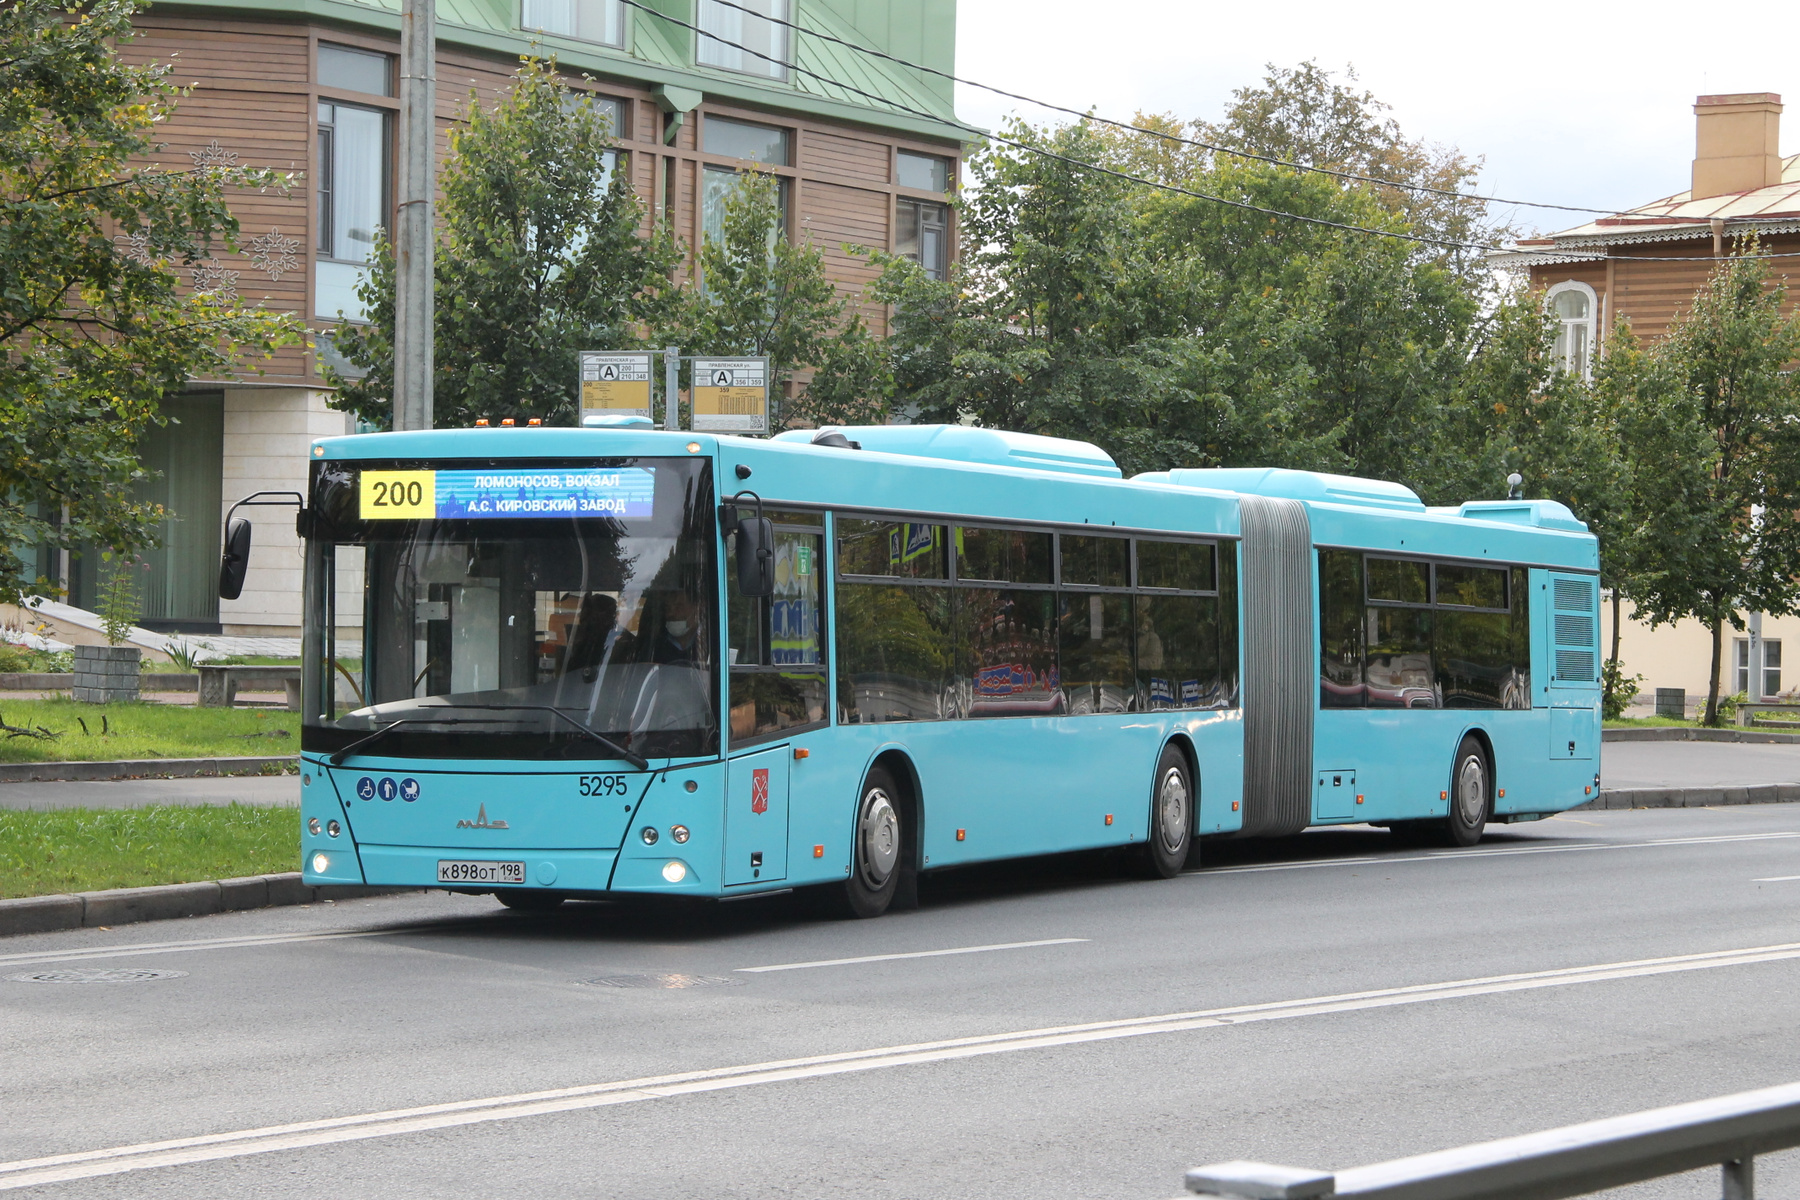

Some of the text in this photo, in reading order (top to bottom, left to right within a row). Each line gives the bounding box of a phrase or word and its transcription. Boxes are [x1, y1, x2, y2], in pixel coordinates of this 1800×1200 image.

[474, 474, 619, 489] ЛОМОНОСОВ, ВОКЗАЛ
[372, 481, 422, 506] 200
[468, 496, 626, 513] А.С. КИРОВСКИЙ ЗАВОД
[579, 775, 627, 796] 5295
[500, 864, 520, 876] 198
